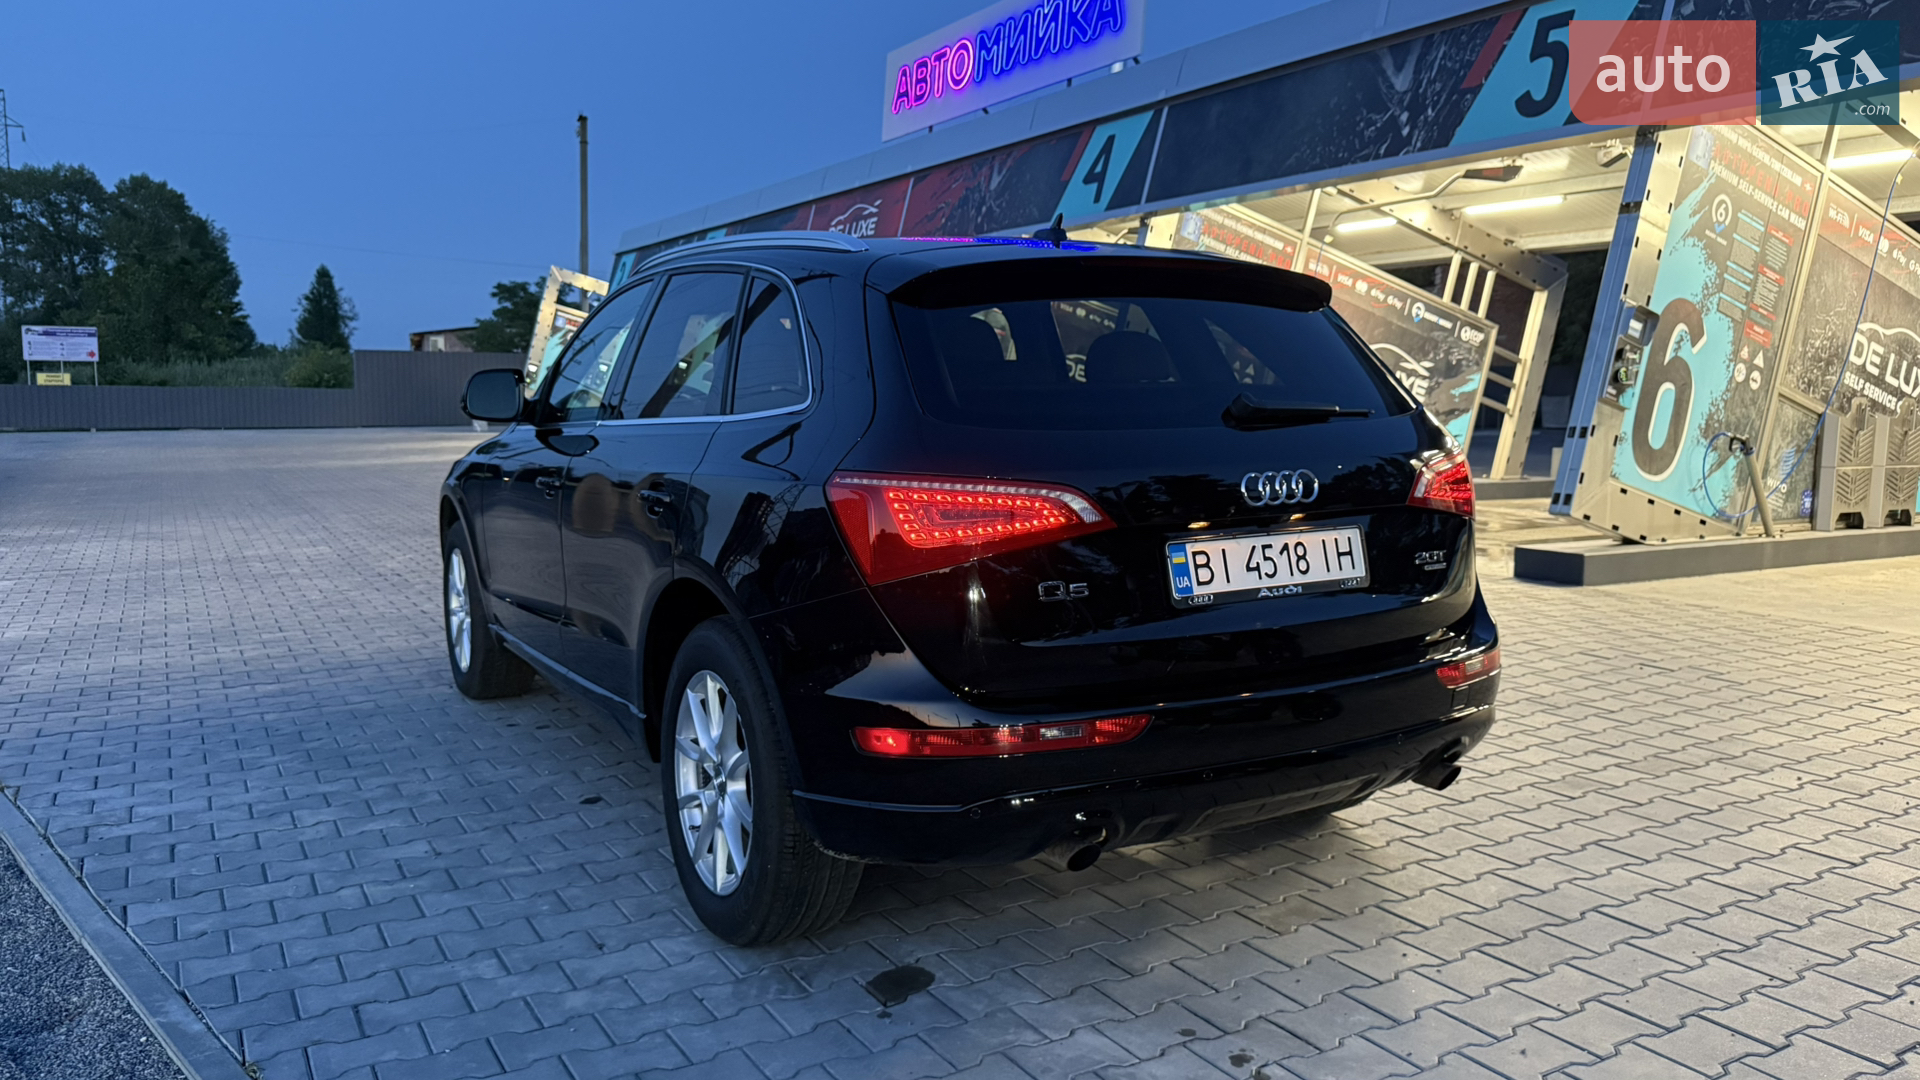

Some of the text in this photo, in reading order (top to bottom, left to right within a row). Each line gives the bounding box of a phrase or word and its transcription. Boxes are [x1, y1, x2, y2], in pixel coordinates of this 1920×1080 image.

[892, 0, 1122, 114] АВТОМИЙКА
[1515, 9, 1575, 118] 5
[1082, 133, 1116, 204] 4
[1717, 203, 1727, 222] 6
[1738, 178, 1778, 213] SELF-SERVICE
[845, 216, 878, 238] LUXE
[1858, 225, 1874, 244] VISA
[1848, 331, 1884, 376] DE
[1631, 297, 1707, 482] 6
[1843, 370, 1864, 391] SELF
[1863, 381, 1898, 411] SERVICE
[1191, 535, 1356, 587] BI 4518 IH
[1038, 580, 1090, 602] Q5
[1176, 576, 1191, 588] UA
[1257, 585, 1303, 598] Audi
